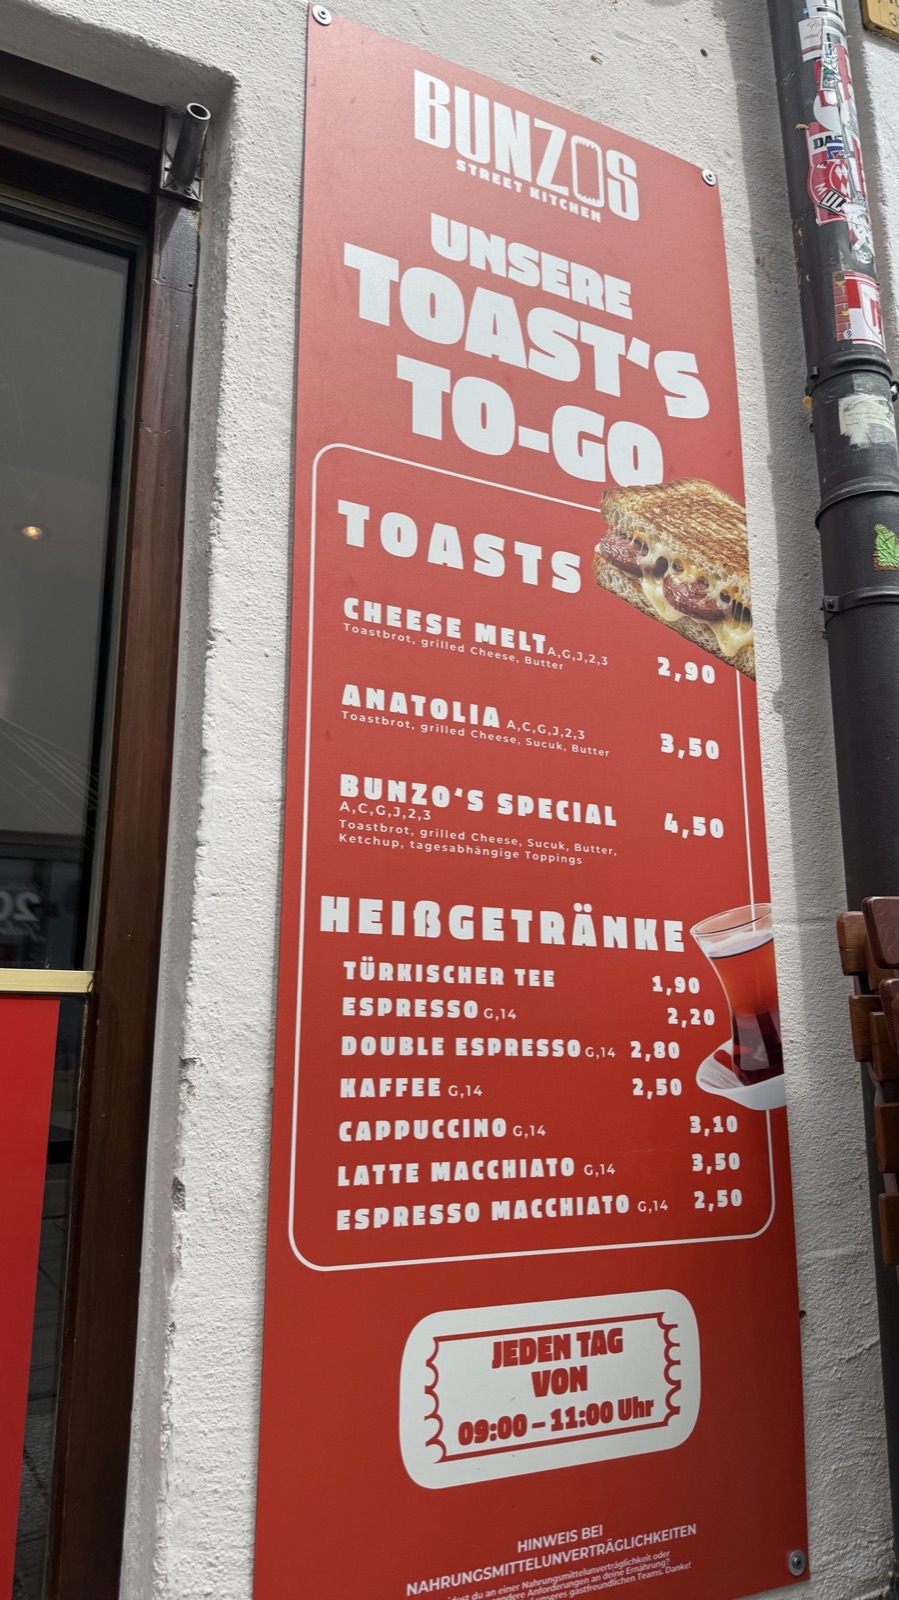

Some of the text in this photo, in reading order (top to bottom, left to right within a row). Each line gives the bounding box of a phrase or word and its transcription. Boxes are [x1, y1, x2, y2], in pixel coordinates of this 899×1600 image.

[414, 70, 640, 223] BUNZOS
[456, 159, 601, 223] STREET KITCHEN
[431, 212, 633, 320] UNSERE
[396, 354, 664, 487] TO-GO
[337, 499, 581, 594] TOASTS
[343, 597, 608, 666] CHEESE MELT A,G,J,2,3
[343, 622, 563, 670] Toastbrot, grilled Cheese, Butter
[657, 656, 716, 684] 2,90
[341, 684, 585, 740] ANATOLIA A,C,G,J,2,3
[341, 710, 610, 757] Toastbrot, grilled Cheese, Sucuk, Butter
[660, 733, 720, 760] 3,50
[339, 801, 431, 821] A,C,G,J,2,3
[497, 793, 617, 827] SPECIAL
[664, 812, 724, 839] 4,50
[339, 819, 617, 856] Toastbrot, grilled Cheese, Sucuk, Butter,
[339, 833, 582, 866] Ketchup, tagesabhängige Toppings
[319, 895, 685, 953] HEIßGETRÄNKE
[343, 955, 700, 996] TÜRKISCHER TEE 1,90
[342, 997, 715, 1028] ESPRESSO G,14 2,20
[341, 1035, 680, 1062] DOUBLE ESPRESSO G,14 2,80
[340, 1077, 682, 1100] KAFFEE G,14 2,50
[338, 1115, 738, 1142] CAPPUCCINO G,14 3,10
[337, 1152, 740, 1187] LATTE MACCHIATO G,14 3,50
[336, 1188, 743, 1231] ESPRESSO MACCHIATO G,14 2,50
[491, 1327, 623, 1369] JEDEN TAG
[531, 1365, 588, 1398] VON
[457, 1413, 527, 1446] 09:00
[550, 1400, 614, 1431] 11:00
[618, 1396, 654, 1421] Uhr
[517, 1524, 603, 1553] HINWEIS BEI
[406, 1523, 697, 1597] NAHRUNGSMITTELUNVERTRÄGLICHKEITEN
[498, 1584, 521, 1594] einer
[653, 1551, 671, 1560] oder
[591, 1574, 601, 1582] an
[603, 1568, 624, 1579] deine
[626, 1558, 670, 1575] Ernährung?
